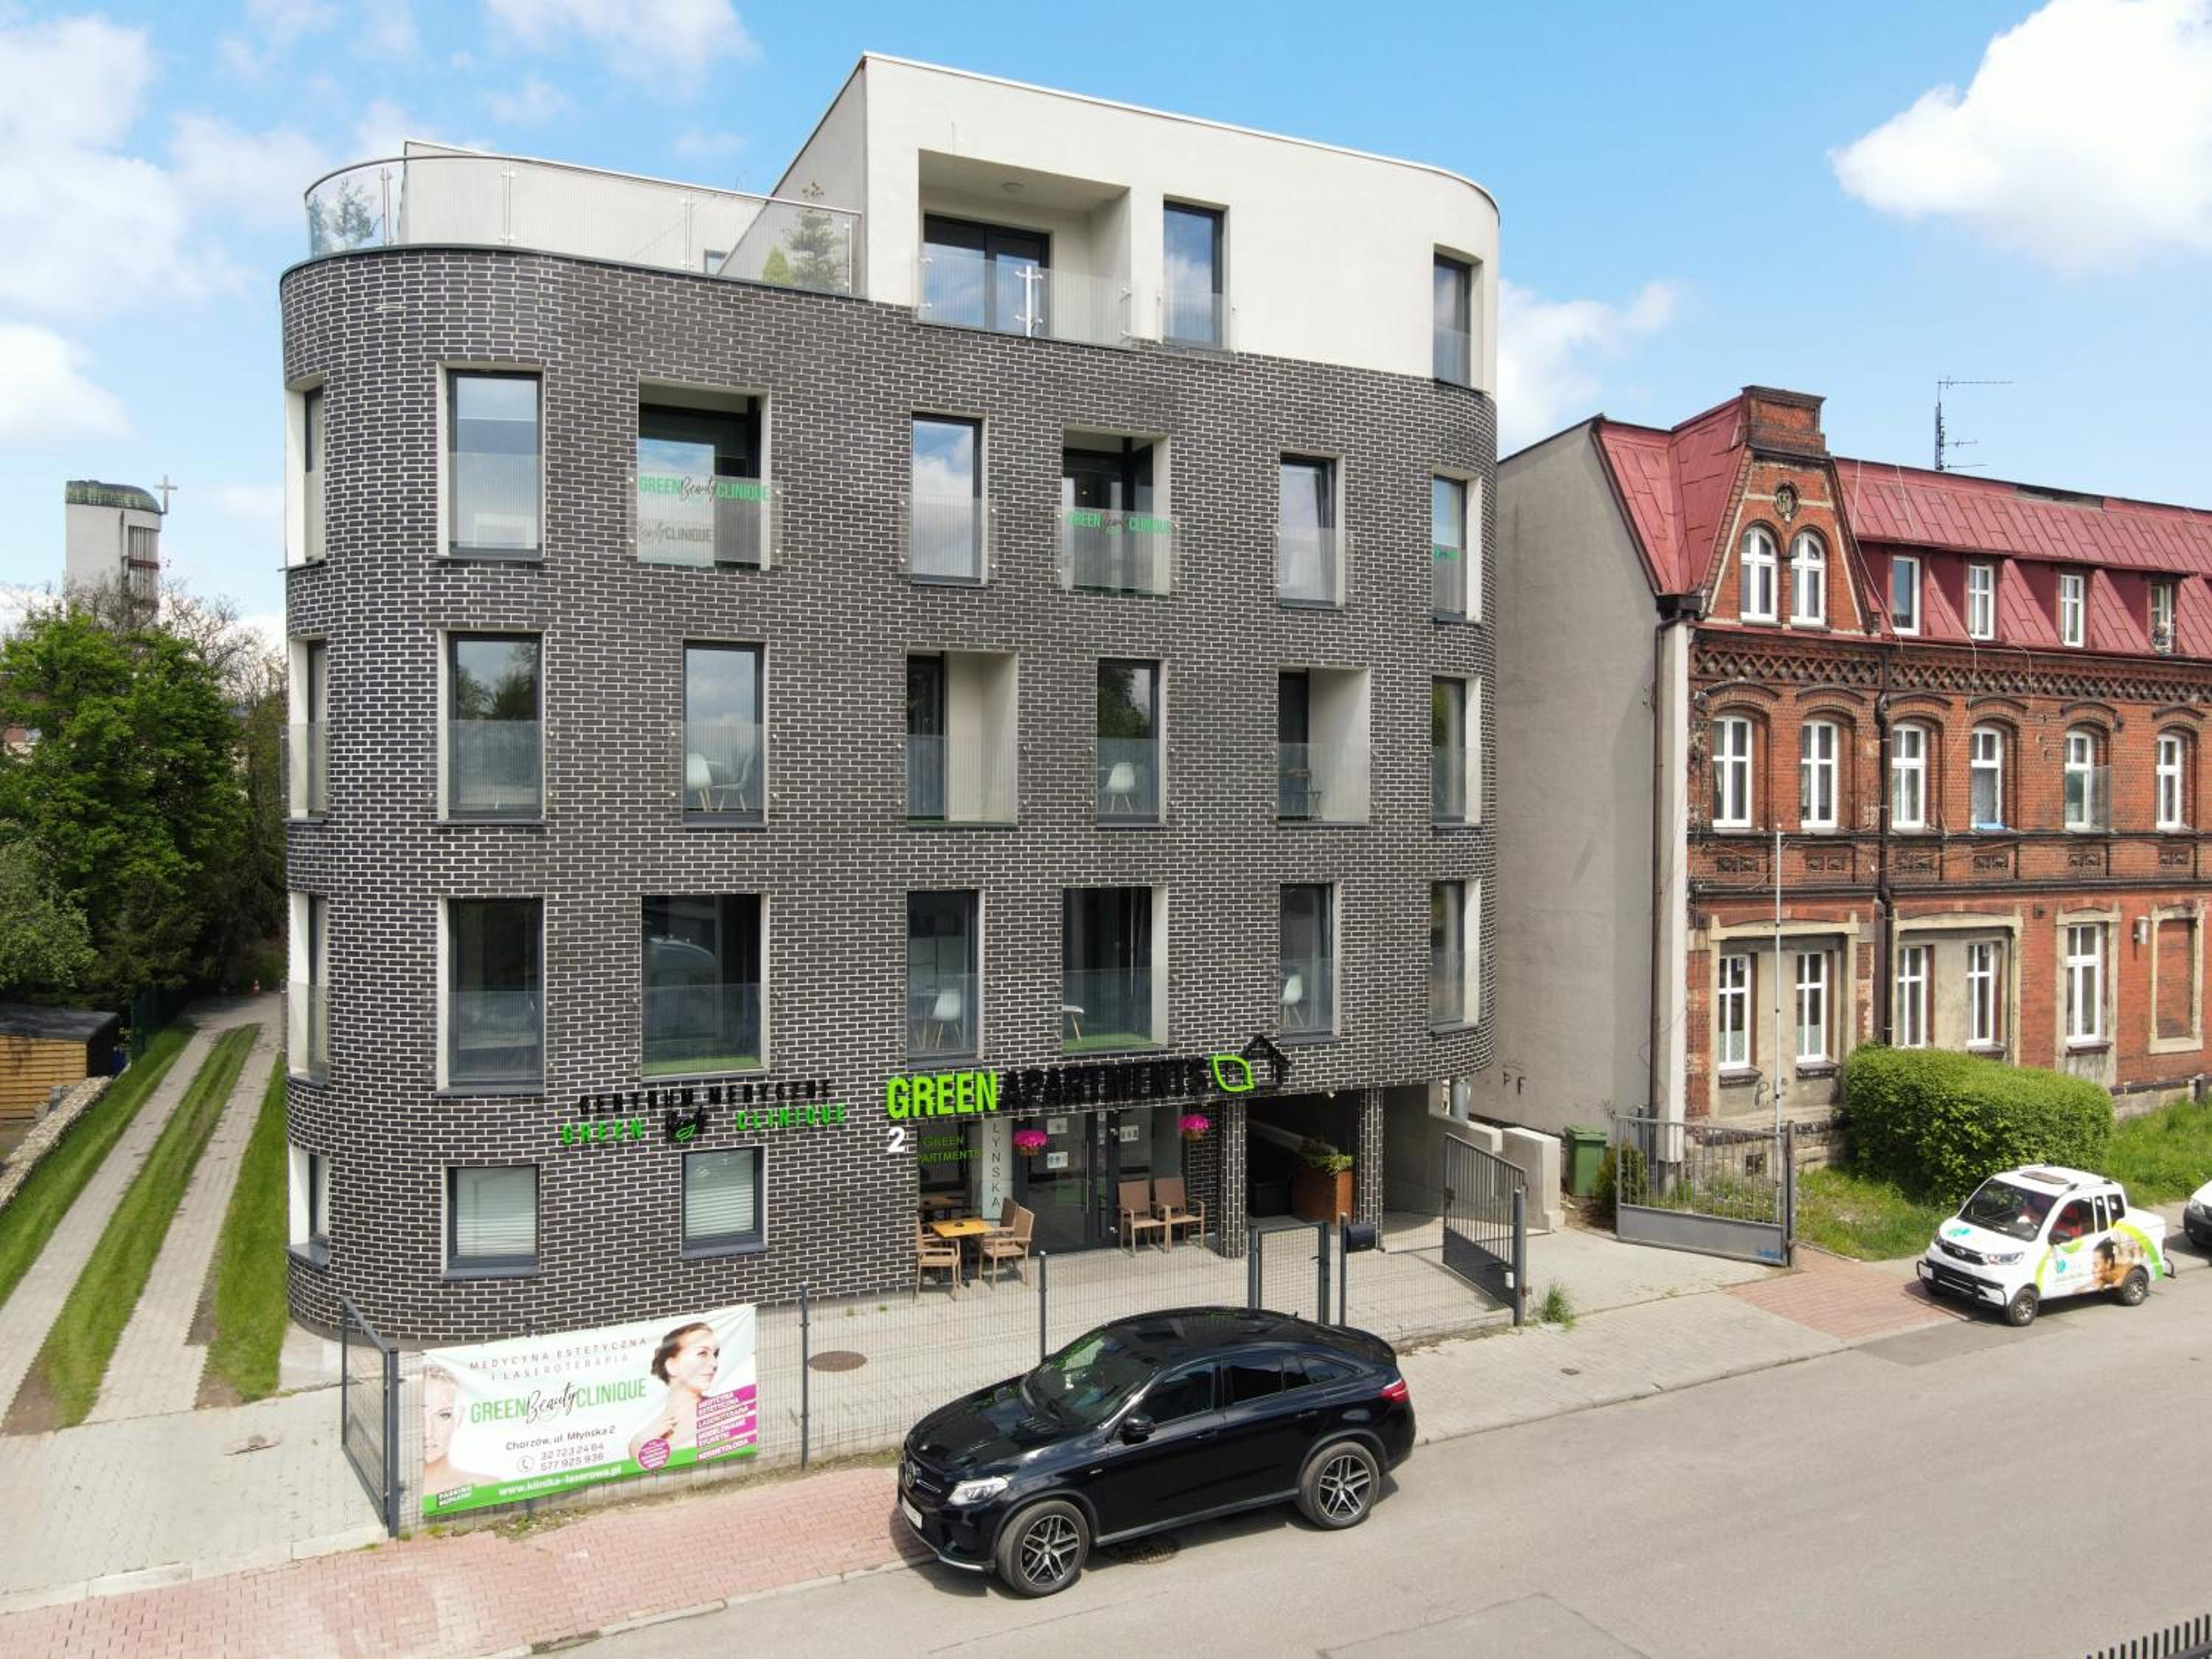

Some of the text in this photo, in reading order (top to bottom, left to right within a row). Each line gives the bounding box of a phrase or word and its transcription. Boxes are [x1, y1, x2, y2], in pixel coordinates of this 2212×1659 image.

[639, 473, 681, 496] GREEN
[714, 481, 770, 502] CLINIQUE
[580, 1088, 694, 1115] CENTRUM
[887, 1070, 998, 1120] GREEN
[562, 1118, 644, 1145] GREEN
[737, 1103, 846, 1131] CLINIQUE
[887, 1126, 905, 1153] 2
[923, 1135, 964, 1147] GREEN
[470, 1337, 647, 1369] MEDYCYNA ESTETYCZNA
[504, 1354, 628, 1380] LASEROTERAPIA
[470, 1377, 647, 1424] GREEN Beauty CLINIQUE
